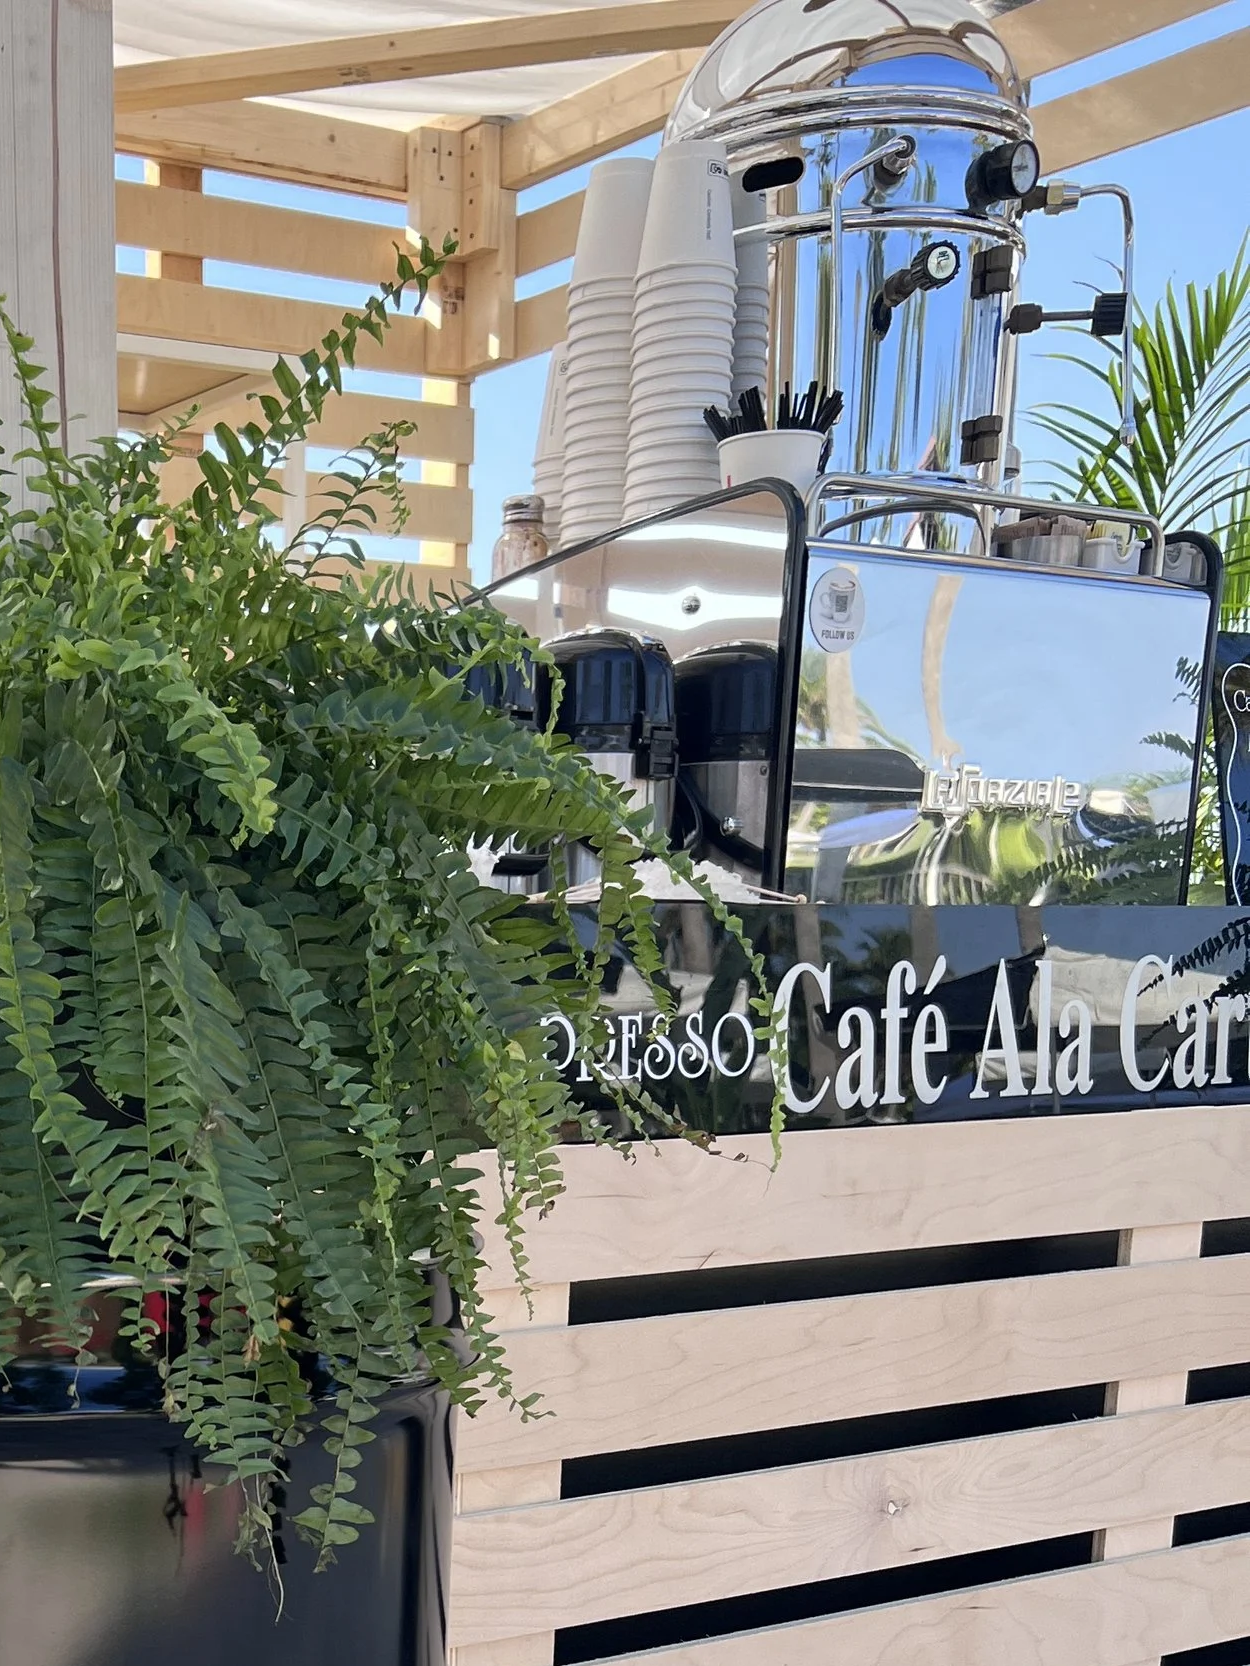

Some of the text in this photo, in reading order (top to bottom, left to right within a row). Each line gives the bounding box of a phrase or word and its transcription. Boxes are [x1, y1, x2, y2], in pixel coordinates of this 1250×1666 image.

[821, 629, 855, 641] FOLLOW US
[523, 1010, 755, 1083] PRESSO
[769, 953, 1250, 1114] Café Ala Car
